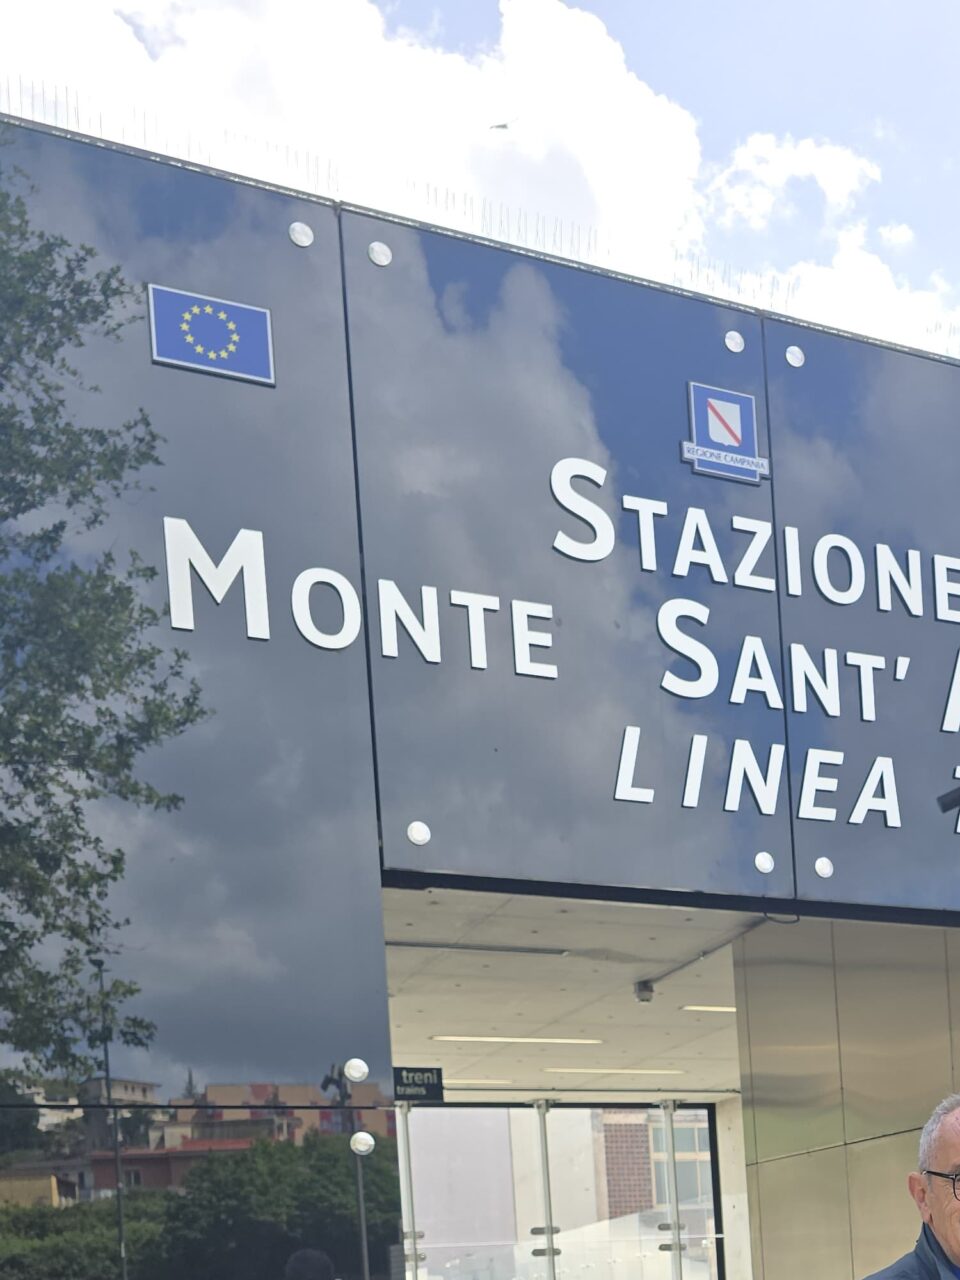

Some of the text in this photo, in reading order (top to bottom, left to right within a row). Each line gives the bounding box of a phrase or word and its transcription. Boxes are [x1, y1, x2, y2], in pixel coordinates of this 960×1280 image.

[686, 446, 766, 470] REGIONE CAMPANIA
[163, 516, 560, 679] MONTE
[657, 598, 911, 721] SANT'
[614, 725, 902, 828] LINEA
[401, 1069, 438, 1084] treni
